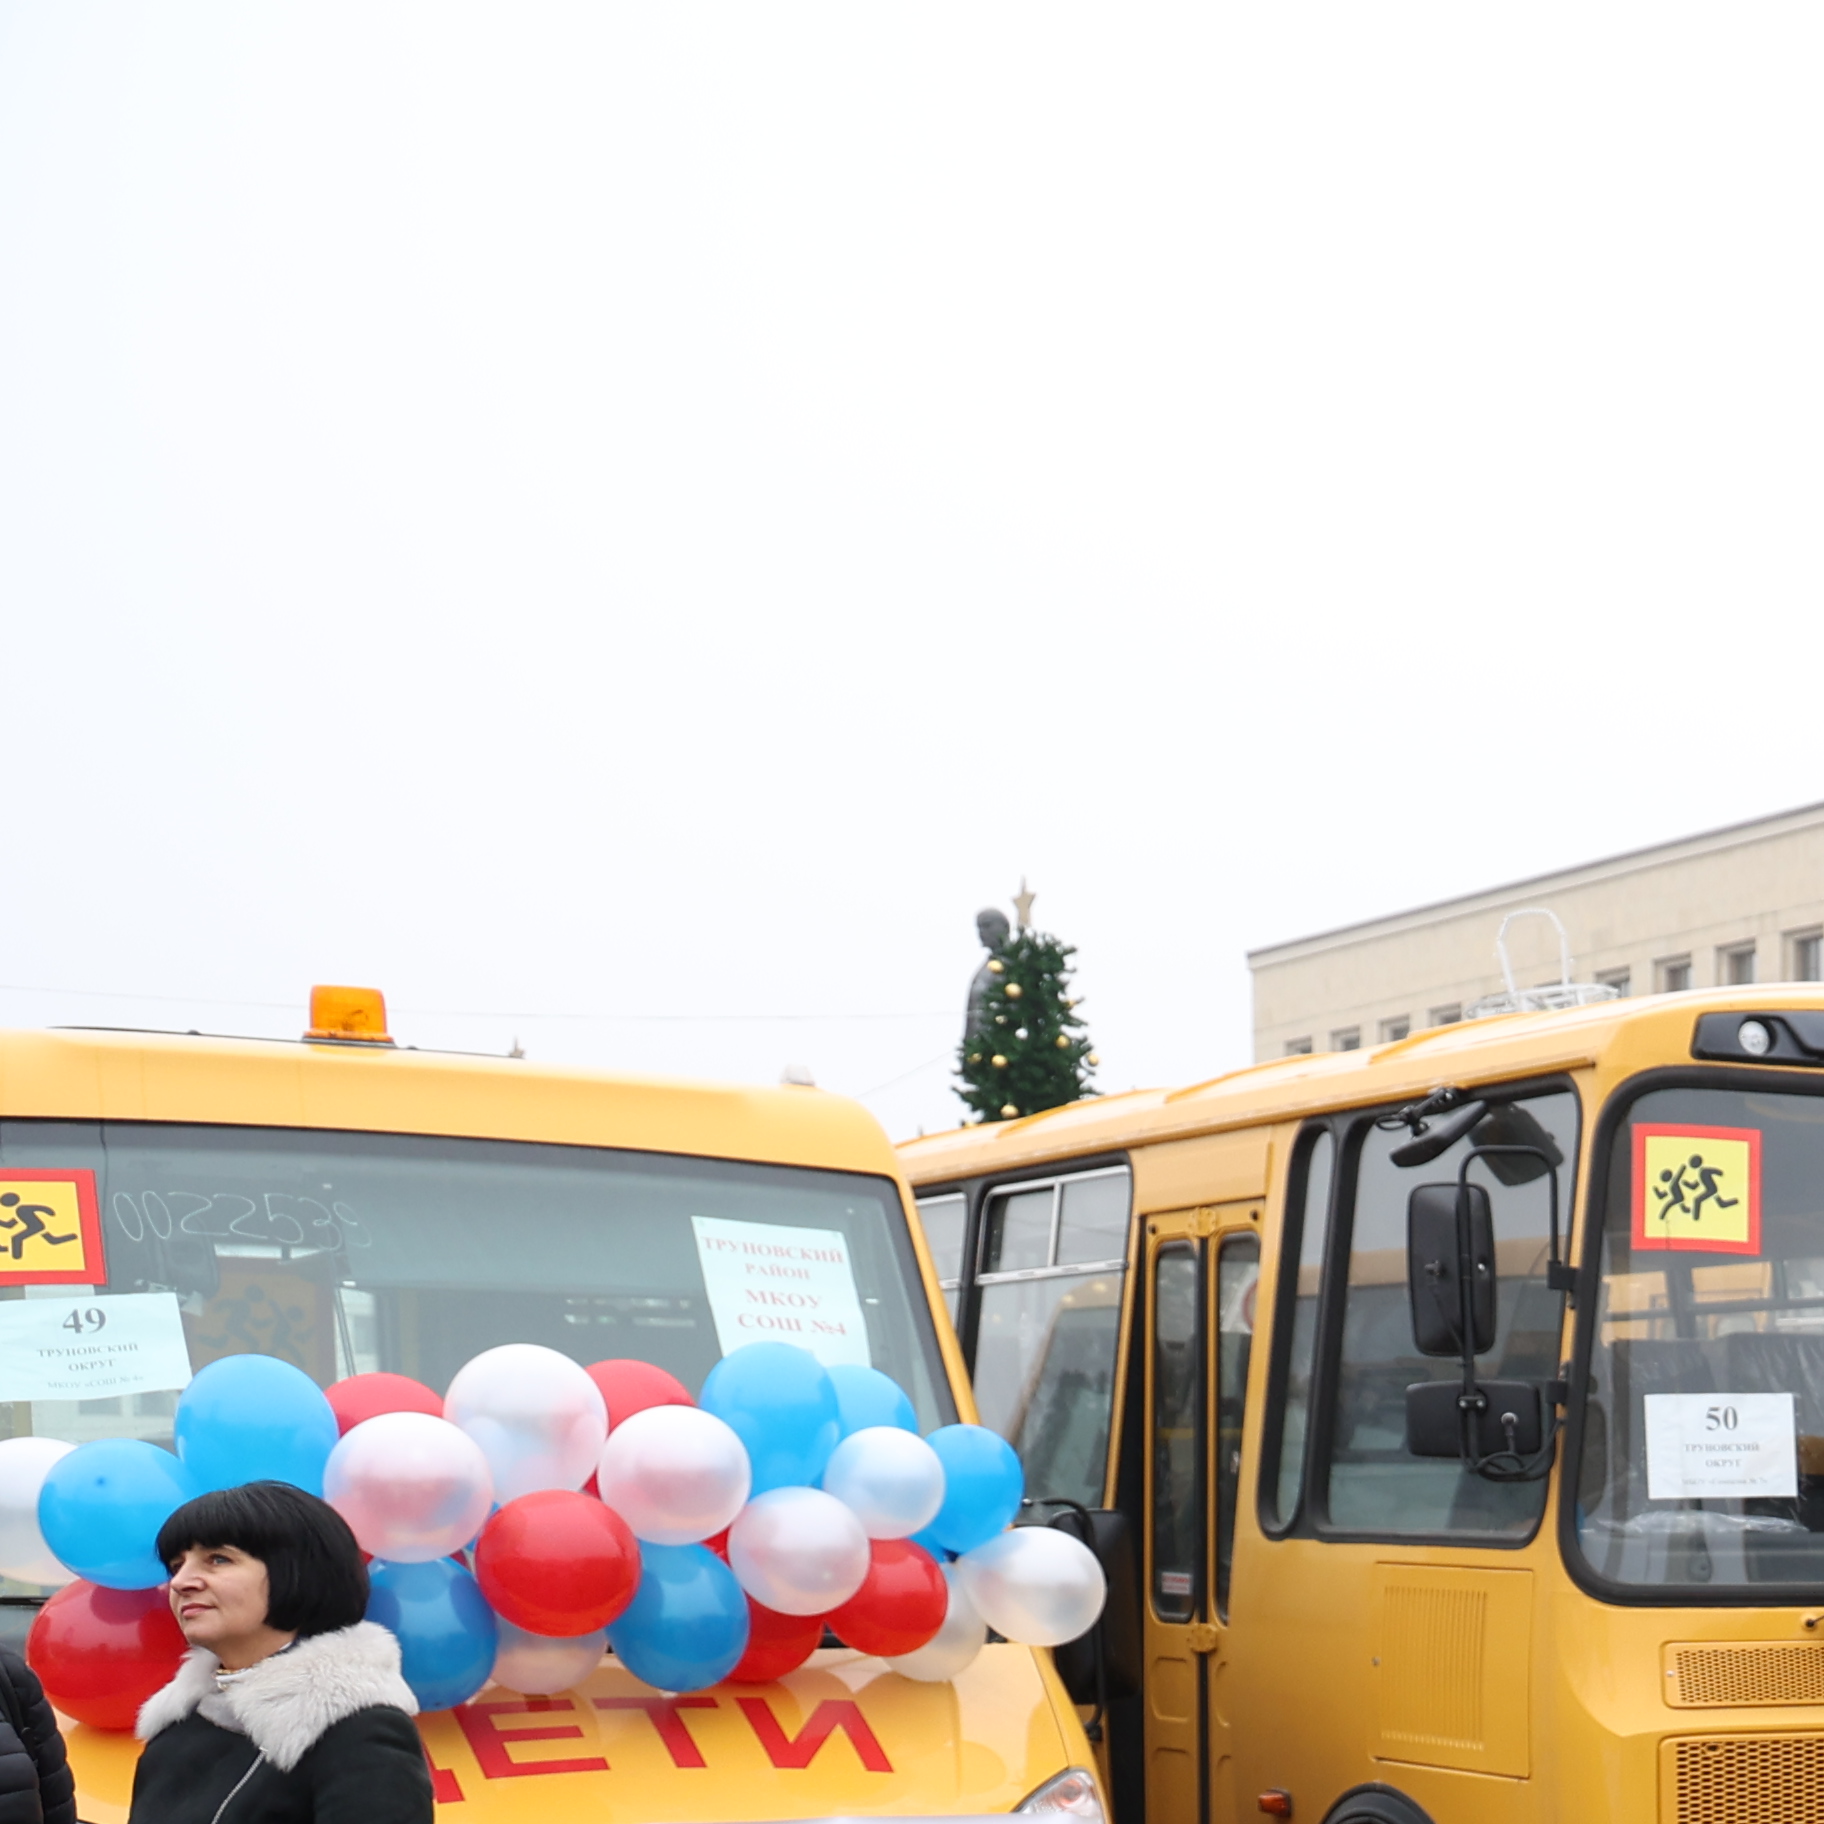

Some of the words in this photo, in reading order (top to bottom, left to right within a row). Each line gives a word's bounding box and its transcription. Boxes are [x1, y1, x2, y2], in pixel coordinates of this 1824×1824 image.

[702, 1236, 845, 1264] ТРУНОВСКИЙ
[745, 1262, 811, 1280] РАЙОН
[745, 1288, 822, 1308] МКОУ
[62, 1307, 107, 1334] 49
[737, 1312, 804, 1332] СОШ
[36, 1342, 140, 1359] ТРУНОВСКИЙ
[68, 1358, 117, 1372] ОКРУГ
[1705, 1406, 1740, 1431] 50
[1684, 1442, 1762, 1453] ТРУНОВСКИЙ
[1705, 1458, 1743, 1468] ОКРУГ
[418, 1696, 895, 1804] ЕТИ
